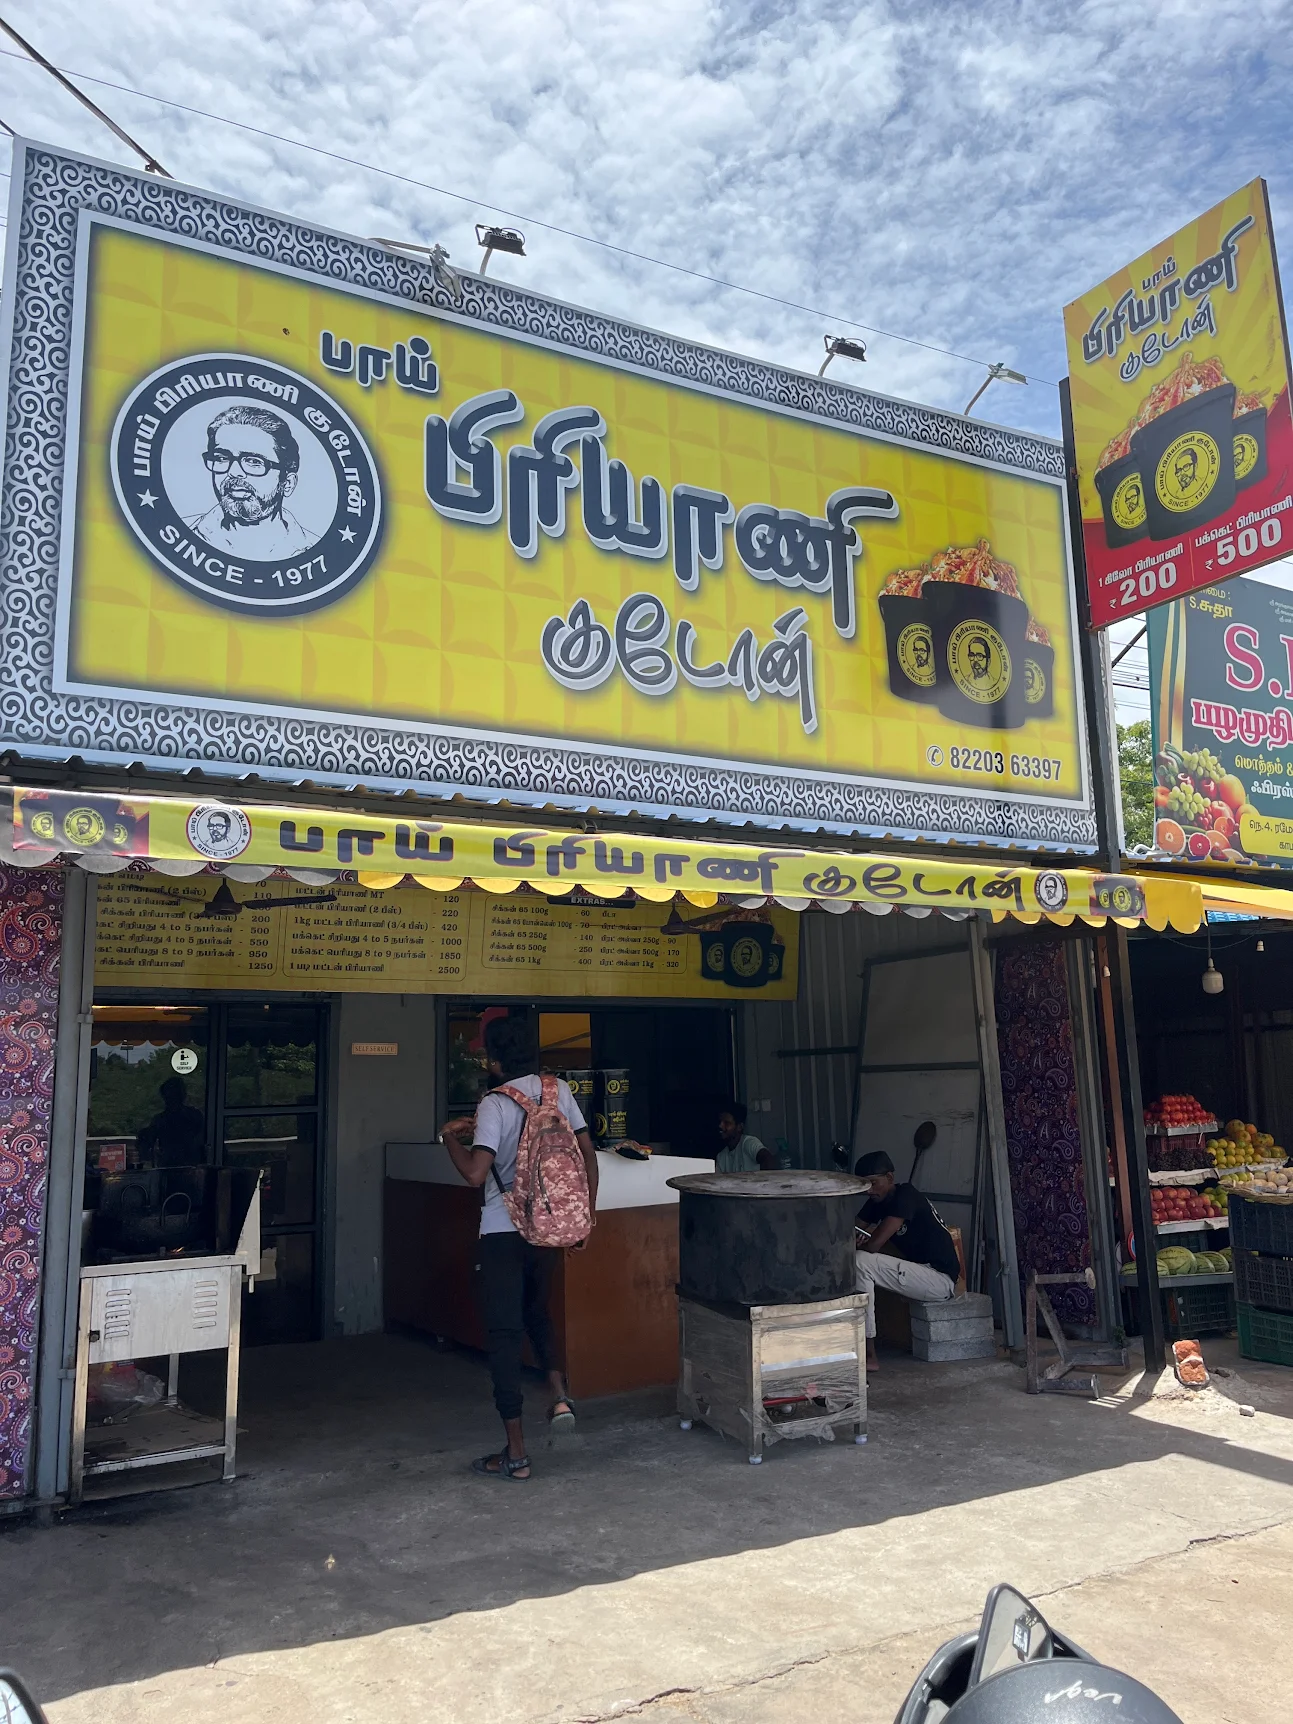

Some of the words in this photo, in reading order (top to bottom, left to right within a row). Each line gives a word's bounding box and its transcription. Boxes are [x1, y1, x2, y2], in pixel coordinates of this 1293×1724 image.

[1141, 256, 1177, 292] பாய்
[1081, 214, 1255, 364] பிரியாணி
[1119, 293, 1217, 384] குடோன்
[319, 328, 440, 394] பாய்
[132, 413, 161, 478] பாய்
[153, 371, 300, 415] பிரியாணி
[303, 405, 368, 518] குடோன்
[1167, 498, 1190, 508] SINCE
[423, 389, 901, 639] பிரியாணி
[1235, 495, 1293, 530] பிரியாணி
[159, 524, 245, 585] SINCE
[271, 554, 329, 588] 1977
[1097, 577, 1103, 588] 1
[1134, 542, 1185, 572] பிரியாணி
[539, 591, 819, 733] குடோன்
[958, 678, 981, 699] SINCE
[987, 686, 1001, 699] 1977
[949, 746, 1005, 775] 82203
[1010, 753, 1062, 781] 63397
[196, 843, 219, 857] SINCE
[279, 820, 454, 863] பாய்
[494, 830, 806, 895] பிரியாணி
[803, 862, 1026, 912] குடோன்
[370, 891, 385, 899] MT
[443, 895, 460, 904] 120
[441, 909, 459, 918] 220
[531, 907, 549, 916] 100g
[251, 915, 270, 924] 200
[170, 923, 181, 931] to
[250, 927, 270, 935] 500
[440, 923, 458, 932] 420
[371, 935, 381, 943] to
[528, 931, 548, 941] 250g
[642, 936, 660, 945] 250g
[249, 939, 269, 947] 550
[440, 937, 463, 946] 1000
[527, 944, 547, 953] 500g
[578, 946, 593, 954] 250
[642, 949, 660, 957] 500g
[667, 949, 680, 957] 170
[248, 950, 268, 958] 950
[373, 950, 384, 958] to
[439, 952, 462, 960] 1850
[248, 962, 273, 970] 1250
[527, 957, 542, 966] 1kg
[437, 966, 460, 975] 2500
